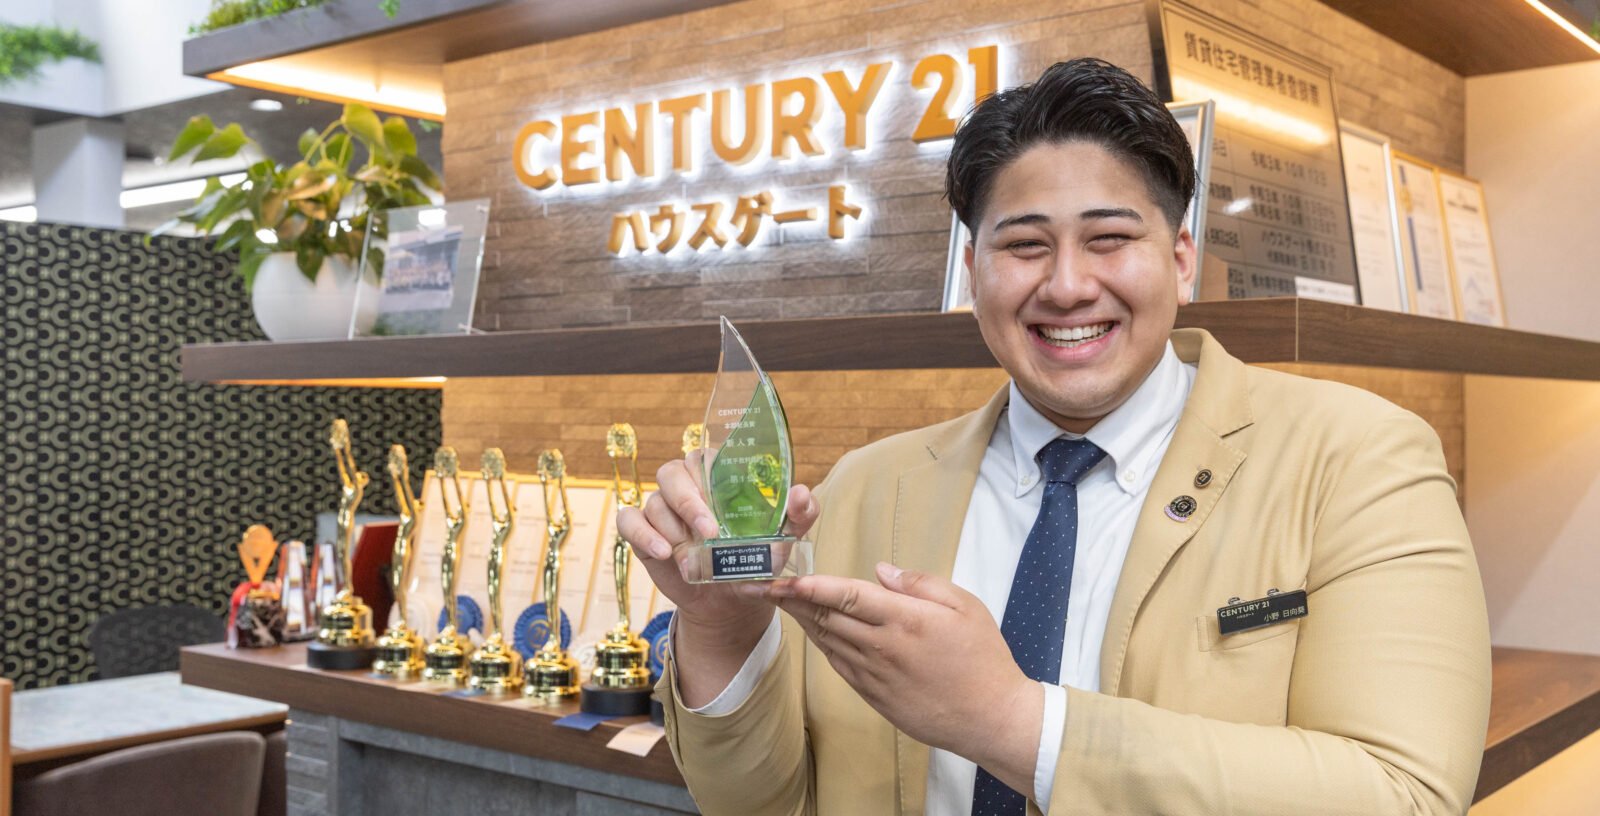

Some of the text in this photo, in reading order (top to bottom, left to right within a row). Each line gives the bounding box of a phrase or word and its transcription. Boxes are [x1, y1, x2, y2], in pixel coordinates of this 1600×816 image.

[512, 61, 894, 190] CENTURY
[606, 184, 862, 255] ハウスゲート
[718, 408, 753, 416] CENTURY
[720, 555, 737, 565] 小野
[1220, 600, 1270, 618] CENTURY 21
[1263, 611, 1279, 622] 小野
